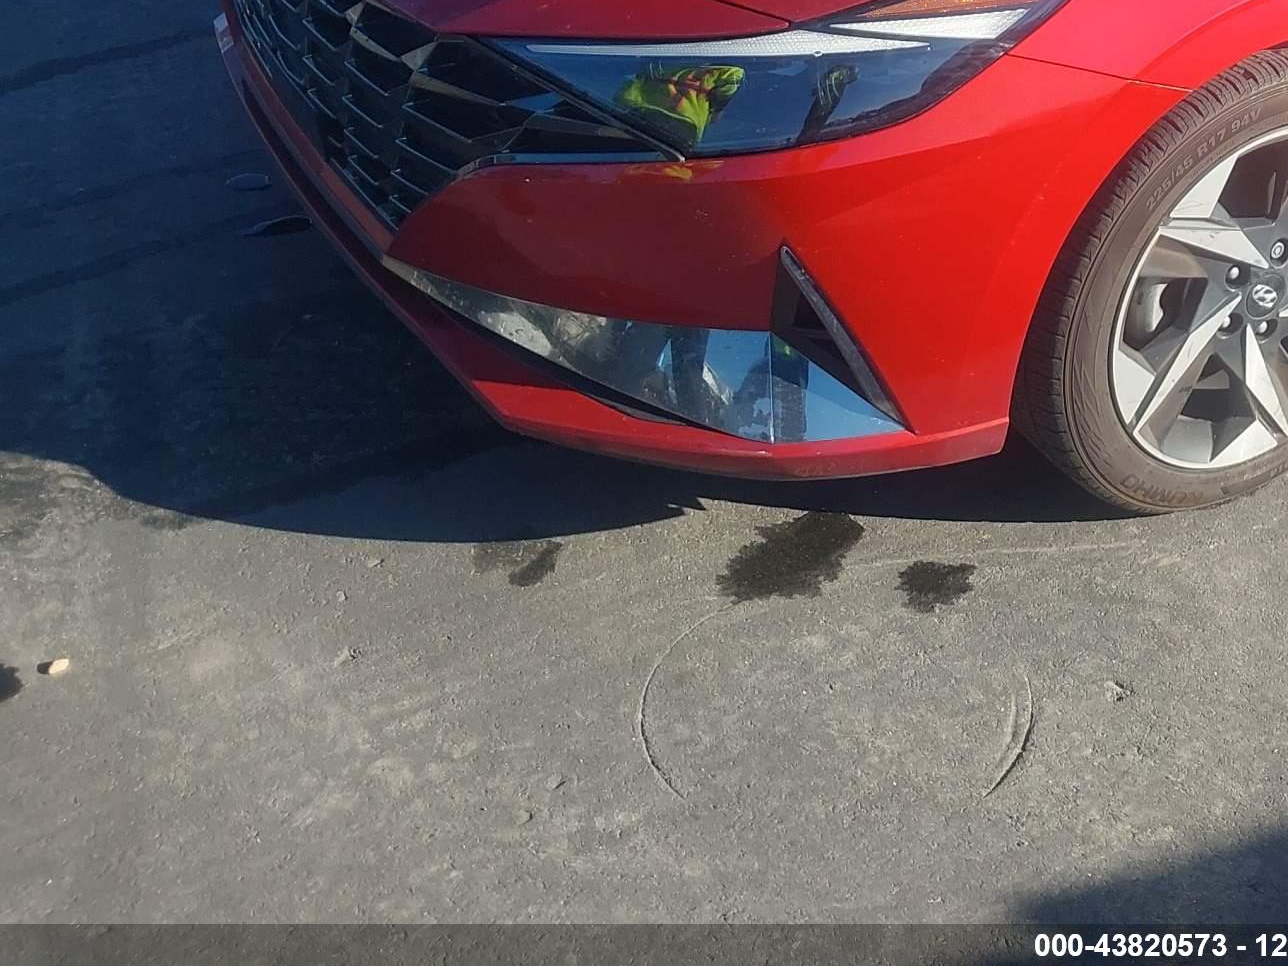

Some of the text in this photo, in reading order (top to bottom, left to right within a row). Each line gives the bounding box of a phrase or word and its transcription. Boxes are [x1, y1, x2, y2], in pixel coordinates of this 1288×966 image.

[1146, 107, 1260, 211] 225/45 R17 94V
